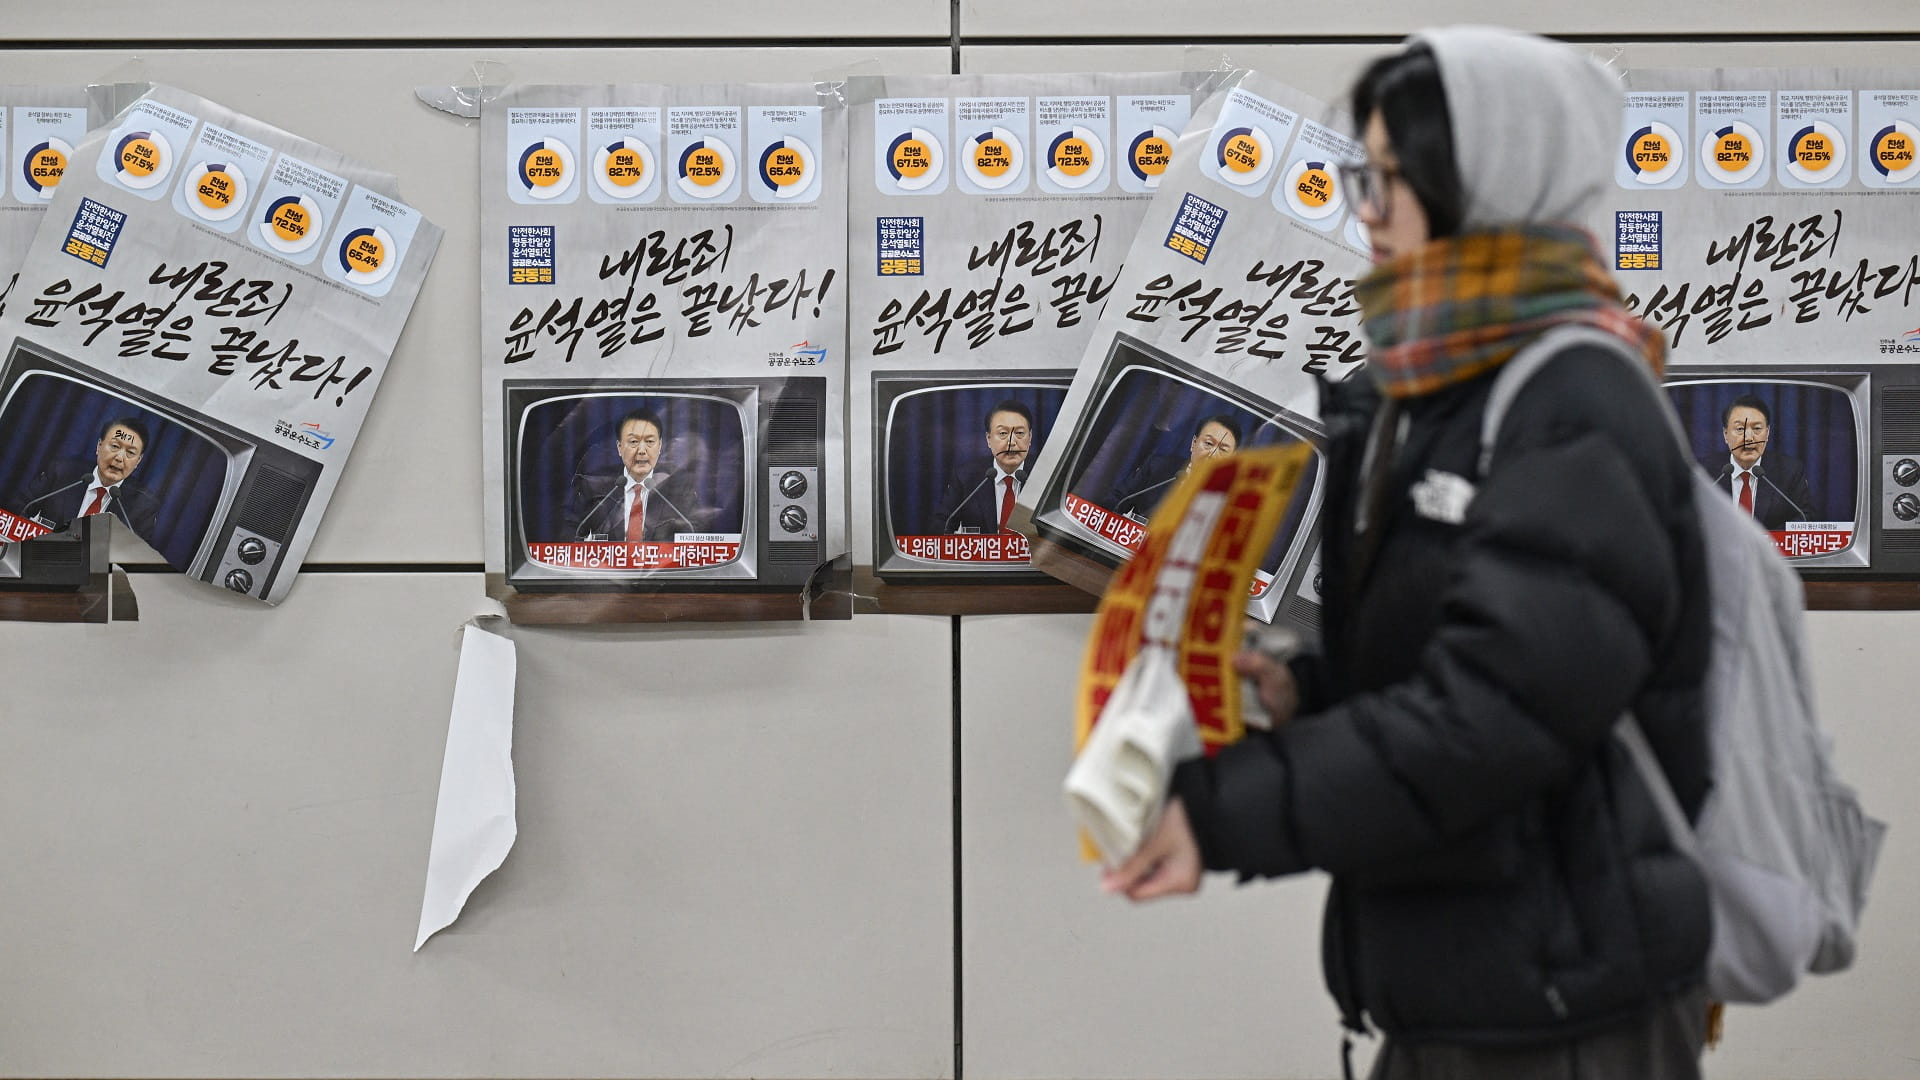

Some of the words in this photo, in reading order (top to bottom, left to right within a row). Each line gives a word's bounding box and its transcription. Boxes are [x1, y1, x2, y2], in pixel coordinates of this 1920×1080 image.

[1065, 145, 1082, 155] 찬성
[1146, 145, 1162, 154] 찬성
[1239, 140, 1255, 155] 찬성
[1643, 140, 1660, 150] 찬성
[1724, 140, 1742, 150] 찬성
[1806, 139, 1823, 149] 찬성
[1887, 139, 1905, 149] 찬성
[136, 144, 154, 158] 찬성
[904, 147, 921, 156] 찬성
[985, 146, 1001, 155] 찬성
[1717, 152, 1749, 161] 82.7%
[1799, 152, 1830, 161] 72.5%
[1880, 151, 1912, 160] 65.4%
[40, 156, 58, 166] 찬성
[124, 152, 154, 171] 67.5%
[536, 155, 553, 165] 찬성
[616, 155, 633, 165] 찬성
[696, 155, 713, 165] 찬성
[777, 154, 794, 164] 찬성
[897, 158, 928, 168] 67.5%
[978, 158, 1009, 167] 82.7%
[1058, 157, 1089, 166] 72.5%
[1138, 156, 1169, 165] 65.4%
[1226, 148, 1255, 168] 67.5%
[1636, 153, 1667, 162] 67.5%
[33, 168, 64, 177] 65.4%
[529, 168, 560, 177] 67.5%
[609, 168, 640, 177] 82.7%
[689, 168, 720, 177] 72.5%
[770, 167, 800, 176] 65.4%
[210, 176, 229, 190] 찬성
[1309, 174, 1328, 189] 찬성
[199, 185, 229, 203] 82.7%
[1298, 182, 1328, 202] 82.7%
[84, 200, 123, 224] 안전한사회
[1187, 195, 1224, 218] 안전한사회
[81, 210, 119, 233] 평등한일상
[285, 208, 304, 223] 찬성
[1184, 205, 1220, 228] 평등한일상
[1619, 213, 1658, 222] 안전한사회
[275, 216, 304, 236] 72.5%
[881, 218, 919, 228] 안전한사회
[1179, 215, 1215, 238] 윤석열퇴진
[1619, 223, 1659, 232] 평등한일상
[76, 220, 114, 243] 윤석열퇴진
[512, 227, 550, 237] 안전한사회
[881, 229, 920, 238] 평등한일상
[512, 238, 551, 247] 평등한일상
[881, 239, 919, 248] 윤석열퇴진
[1169, 233, 1196, 255] 공동
[1619, 233, 1658, 243] 윤석열퇴진
[1706, 209, 1842, 272] 내란죄
[66, 238, 95, 260] 공동
[359, 239, 378, 254] 찬성
[512, 248, 551, 257] 윤석열퇴진
[968, 214, 1102, 279] 내란죄
[348, 248, 379, 267] 65.4%
[599, 224, 733, 288] 내란죄
[1619, 254, 1645, 268] 공동
[881, 259, 907, 274] 공동
[512, 268, 539, 283] 공동
[148, 261, 294, 326] 내란죄
[504, 287, 665, 365] 윤석열은
[682, 268, 836, 337] 끝났다!
[872, 277, 1034, 355] 윤석열은
[1126, 273, 1289, 359] 윤석열은
[25, 279, 193, 361] 윤석열은
[208, 326, 372, 407] 끝났다!
[768, 358, 816, 366] 공공운수노조
[274, 424, 320, 449] 공공운수노조
[0, 511, 15, 537] 해
[1077, 504, 1107, 533] 위해
[912, 538, 941, 559] 위해
[945, 538, 1000, 560] 비상계엄
[544, 546, 570, 566] 위해
[575, 546, 627, 567] 비상계엄
